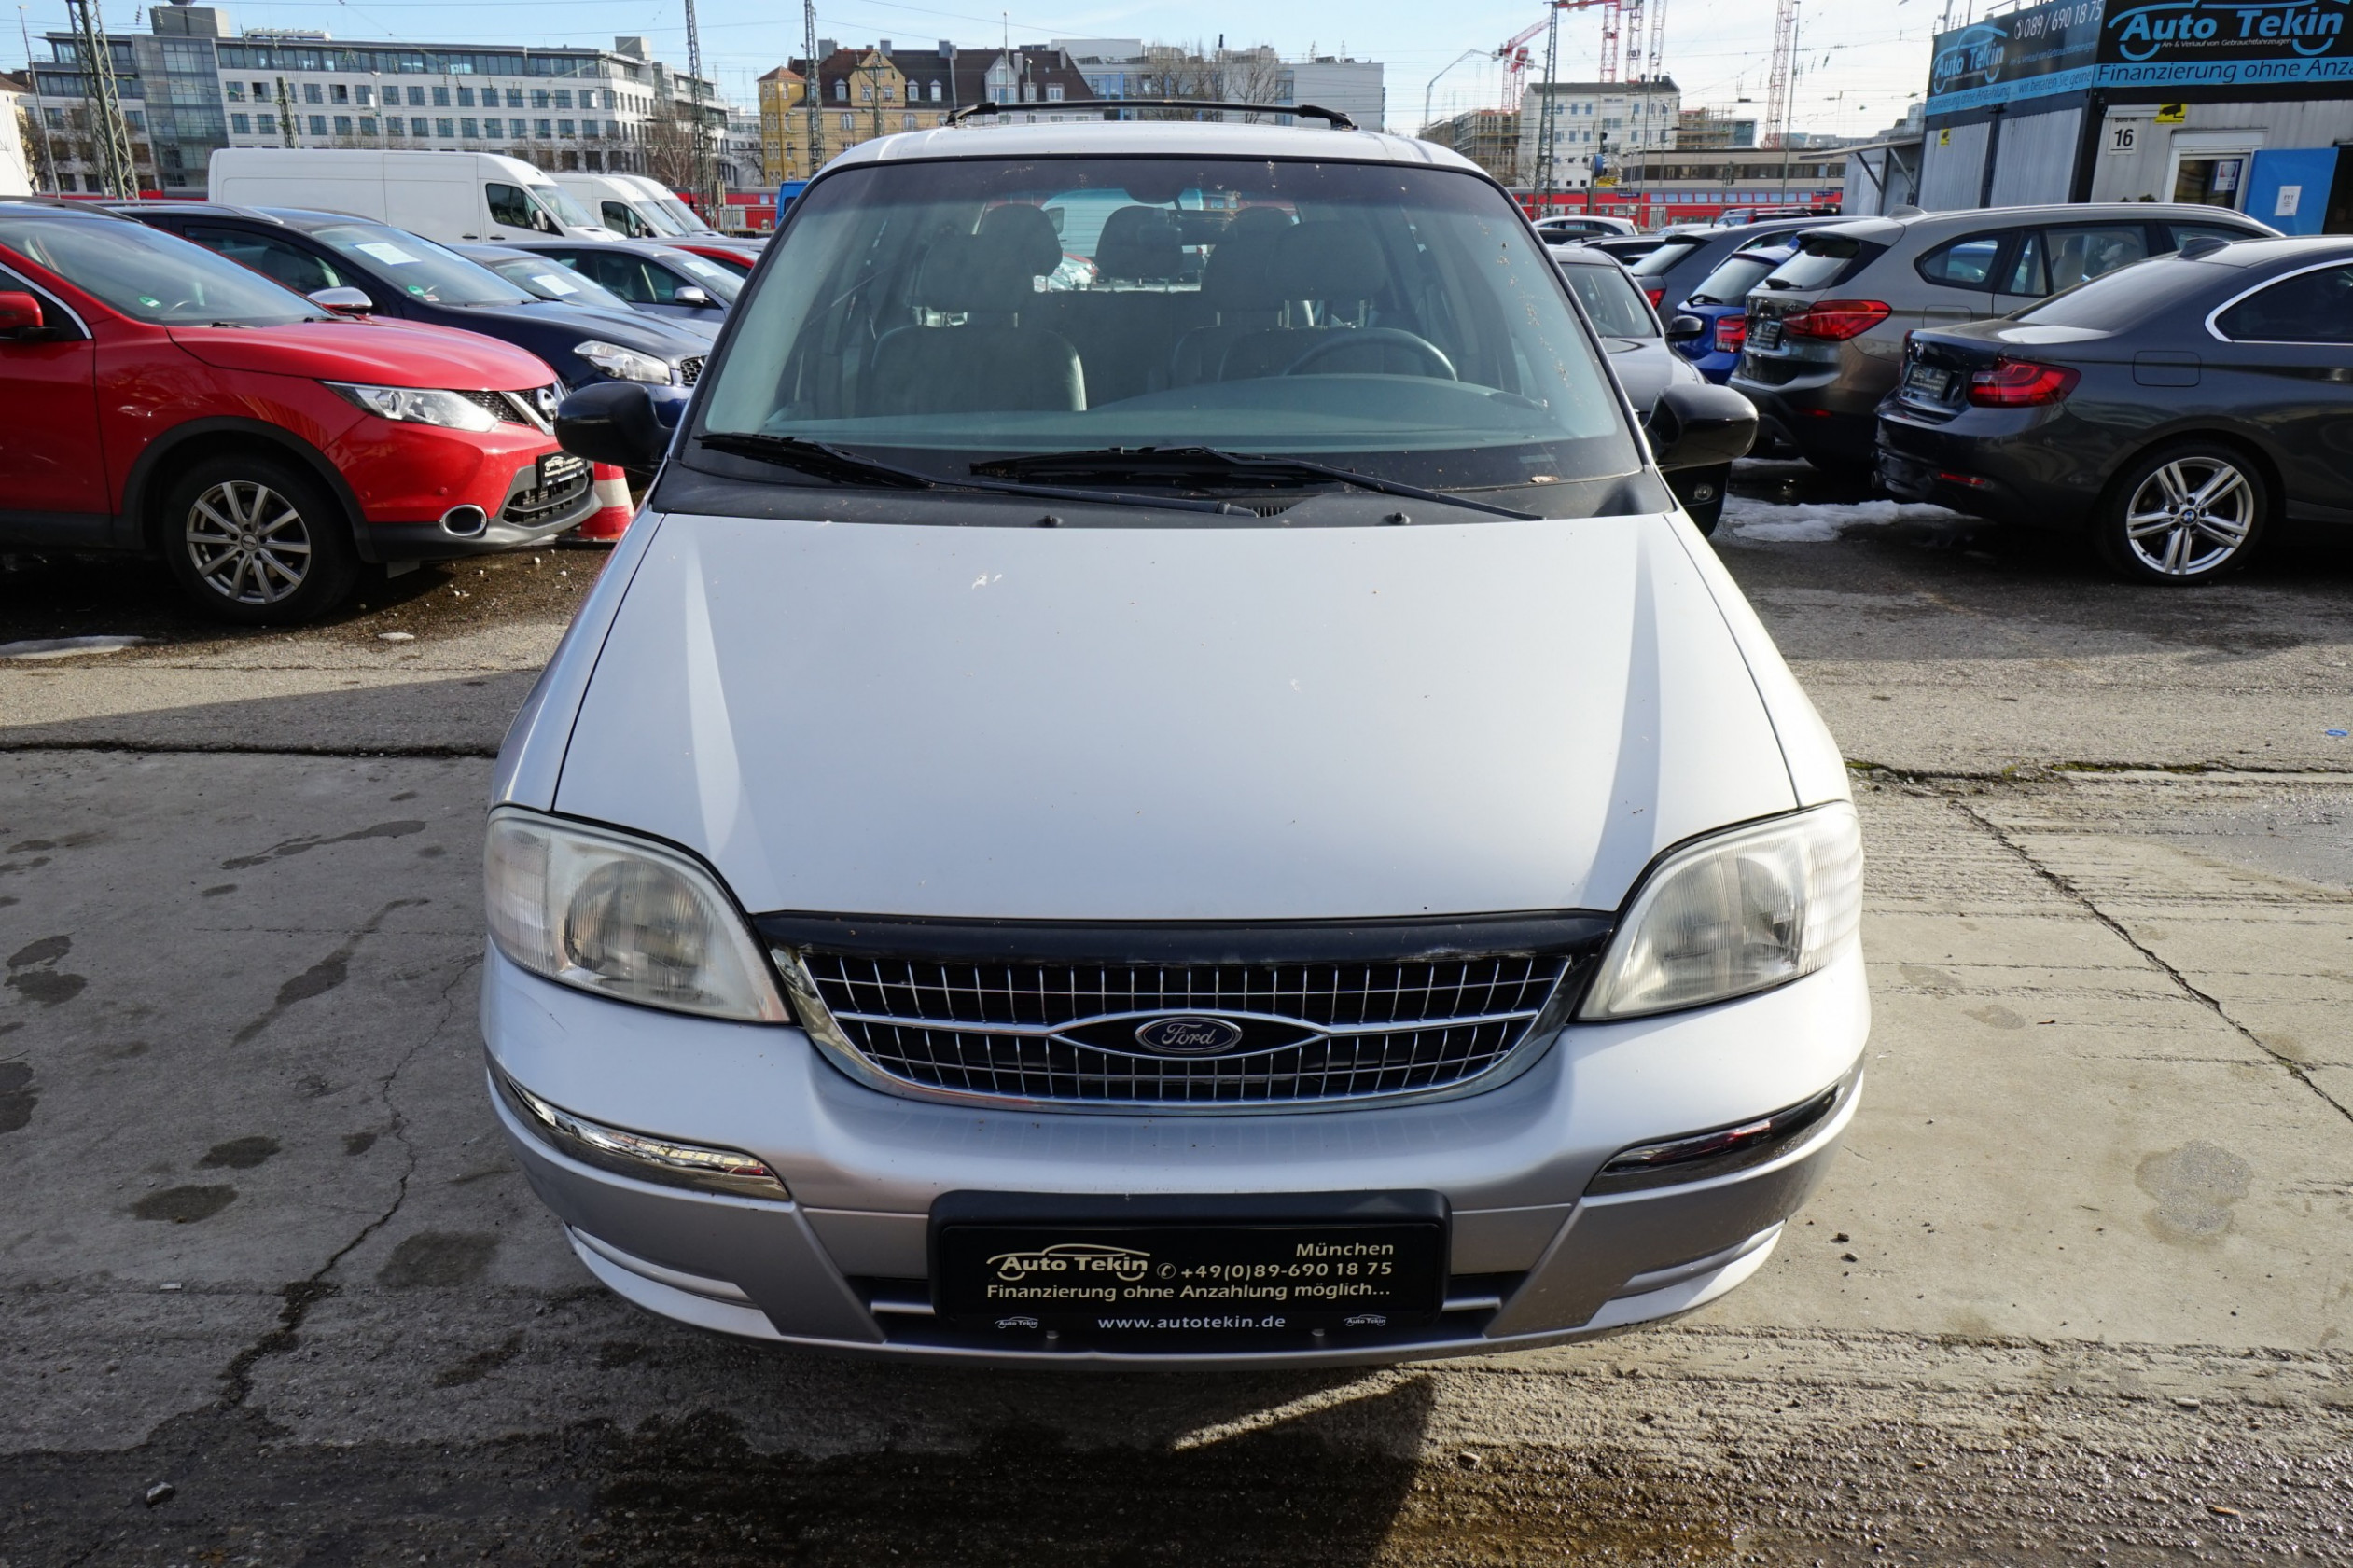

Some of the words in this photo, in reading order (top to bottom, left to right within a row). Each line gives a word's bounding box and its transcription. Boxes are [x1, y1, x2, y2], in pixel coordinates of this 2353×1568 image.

[2074, 3, 2088, 25] 18
[2088, 0, 2102, 22] 75
[2118, 13, 2218, 42] Auto
[2236, 7, 2344, 38] Tekin
[1934, 53, 1965, 79] Auto
[1969, 42, 2004, 71] Tekin
[2097, 62, 2237, 84] Finanzierung
[2244, 61, 2301, 78] ohne
[2114, 128, 2134, 147] 16
[1161, 1023, 1217, 1046] Ford
[1296, 1242, 1394, 1257] München
[1000, 1256, 1068, 1272] Auto
[1073, 1256, 1149, 1272] Tekin
[1181, 1263, 1330, 1282] +49(0)89-690
[1336, 1262, 1359, 1277] 18
[1367, 1261, 1393, 1276] 75
[987, 1284, 1117, 1302] Finanzierung
[1123, 1284, 1175, 1298] ohne
[1179, 1284, 1288, 1301] Anzahlung
[1097, 1315, 1287, 1329] www.autotekin.de
[1366, 1316, 1386, 1325] Tekin
